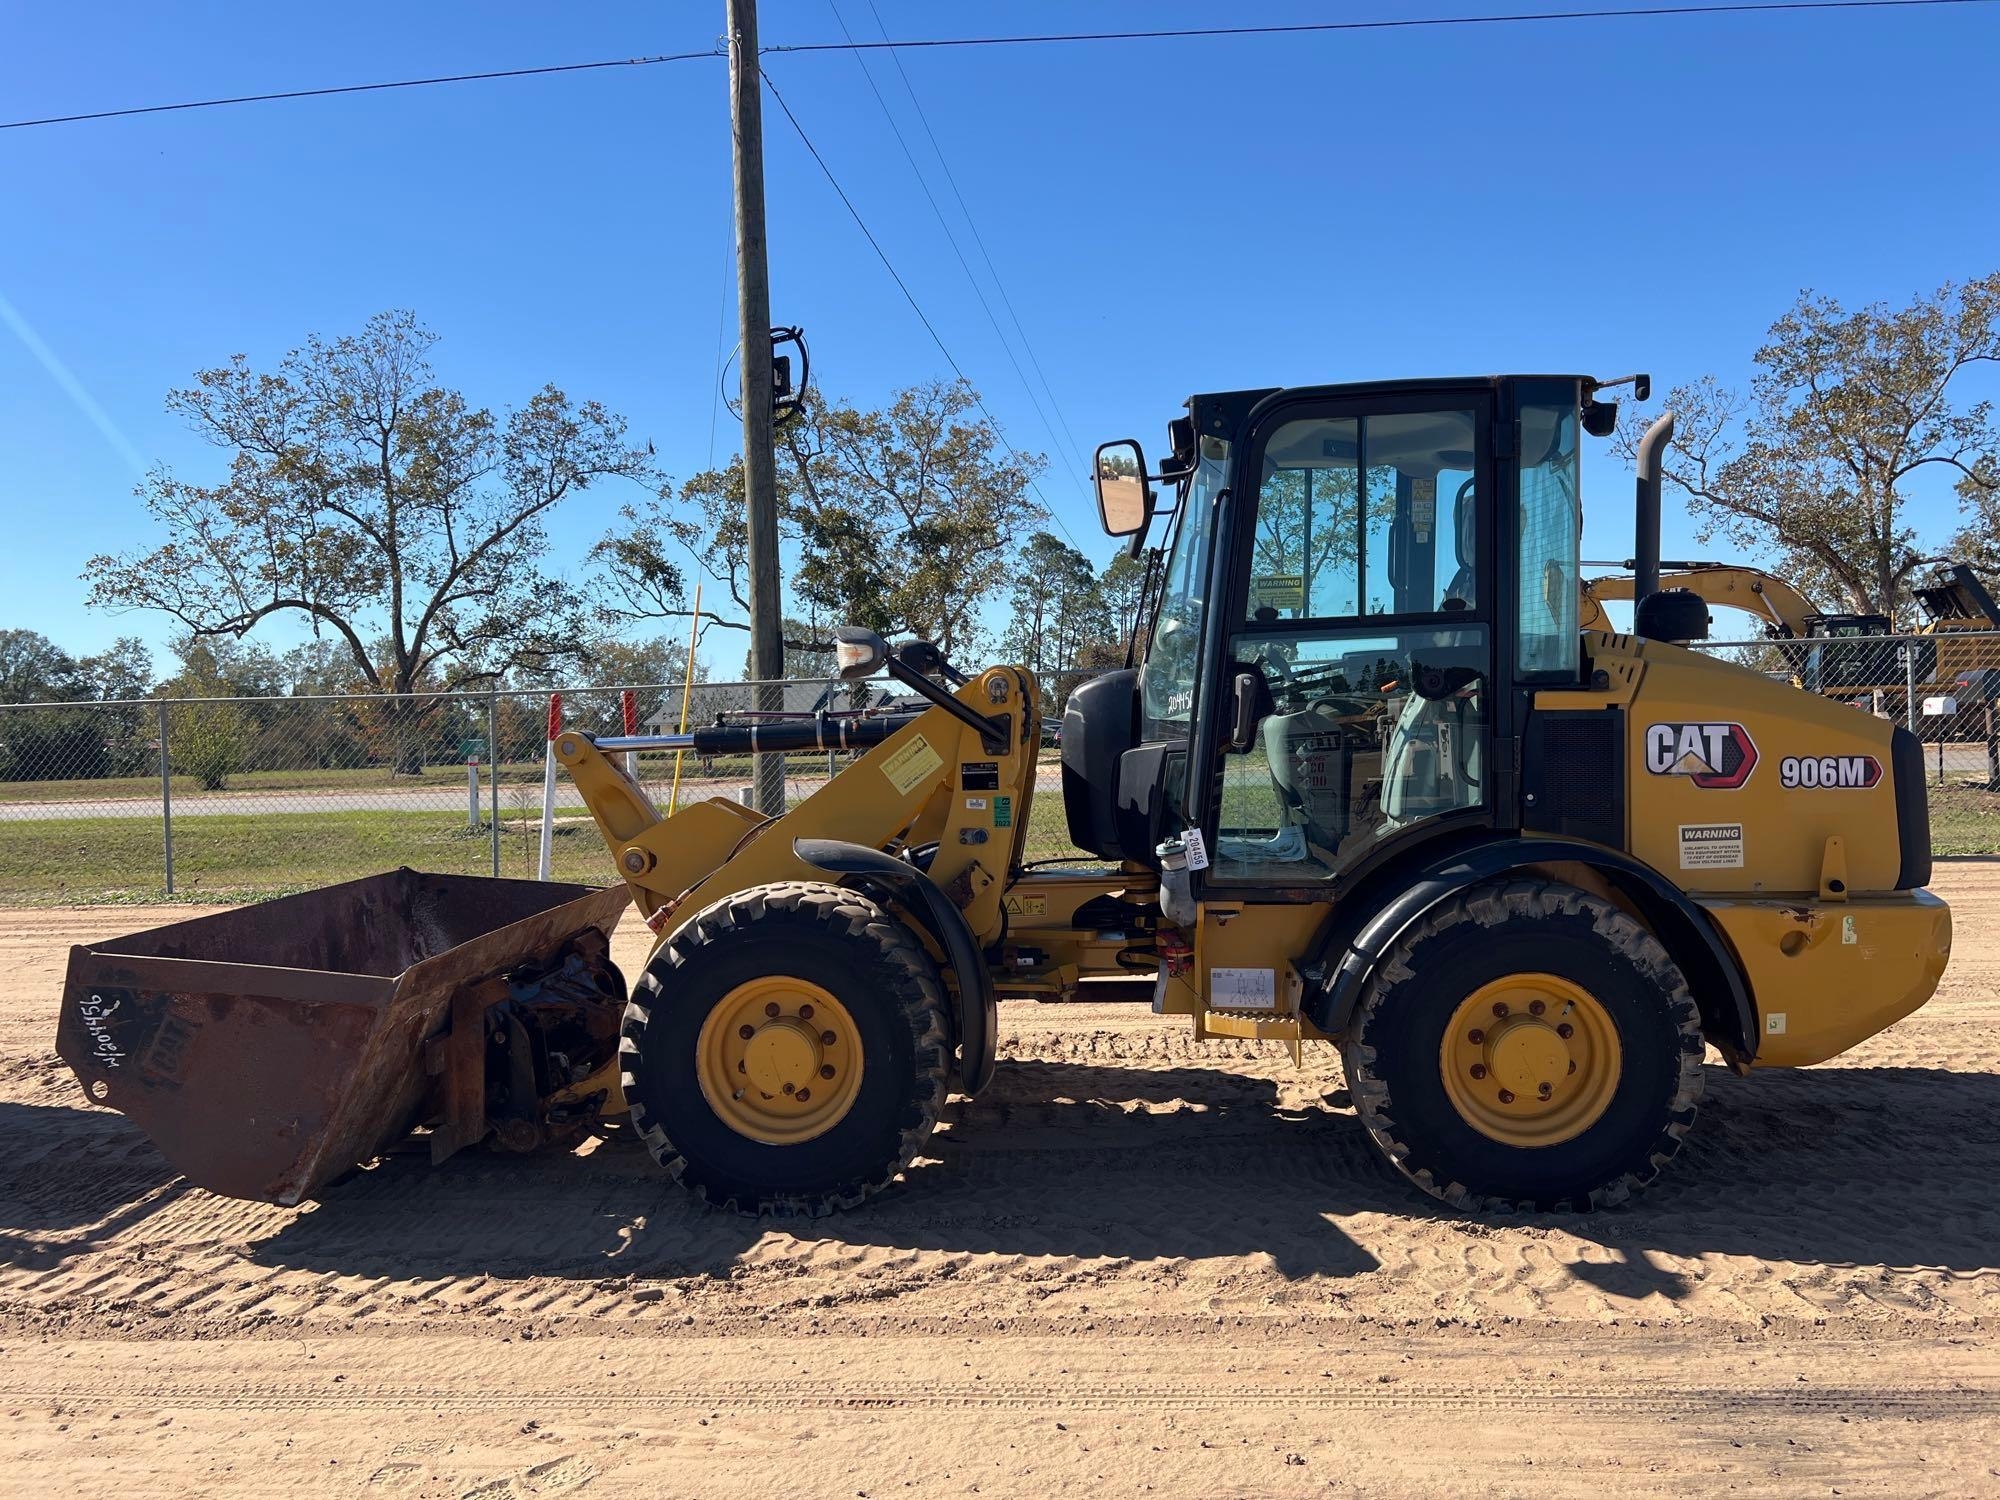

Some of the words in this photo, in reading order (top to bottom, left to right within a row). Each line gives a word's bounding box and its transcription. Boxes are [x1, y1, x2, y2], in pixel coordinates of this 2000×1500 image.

[1259, 579, 1301, 588] WARNING
[1897, 646, 1921, 660] CT
[1648, 724, 1730, 773] CAT
[1781, 757, 1865, 787] 906M
[1684, 829, 1739, 839] WARNING
[1189, 837, 1204, 865] 204456
